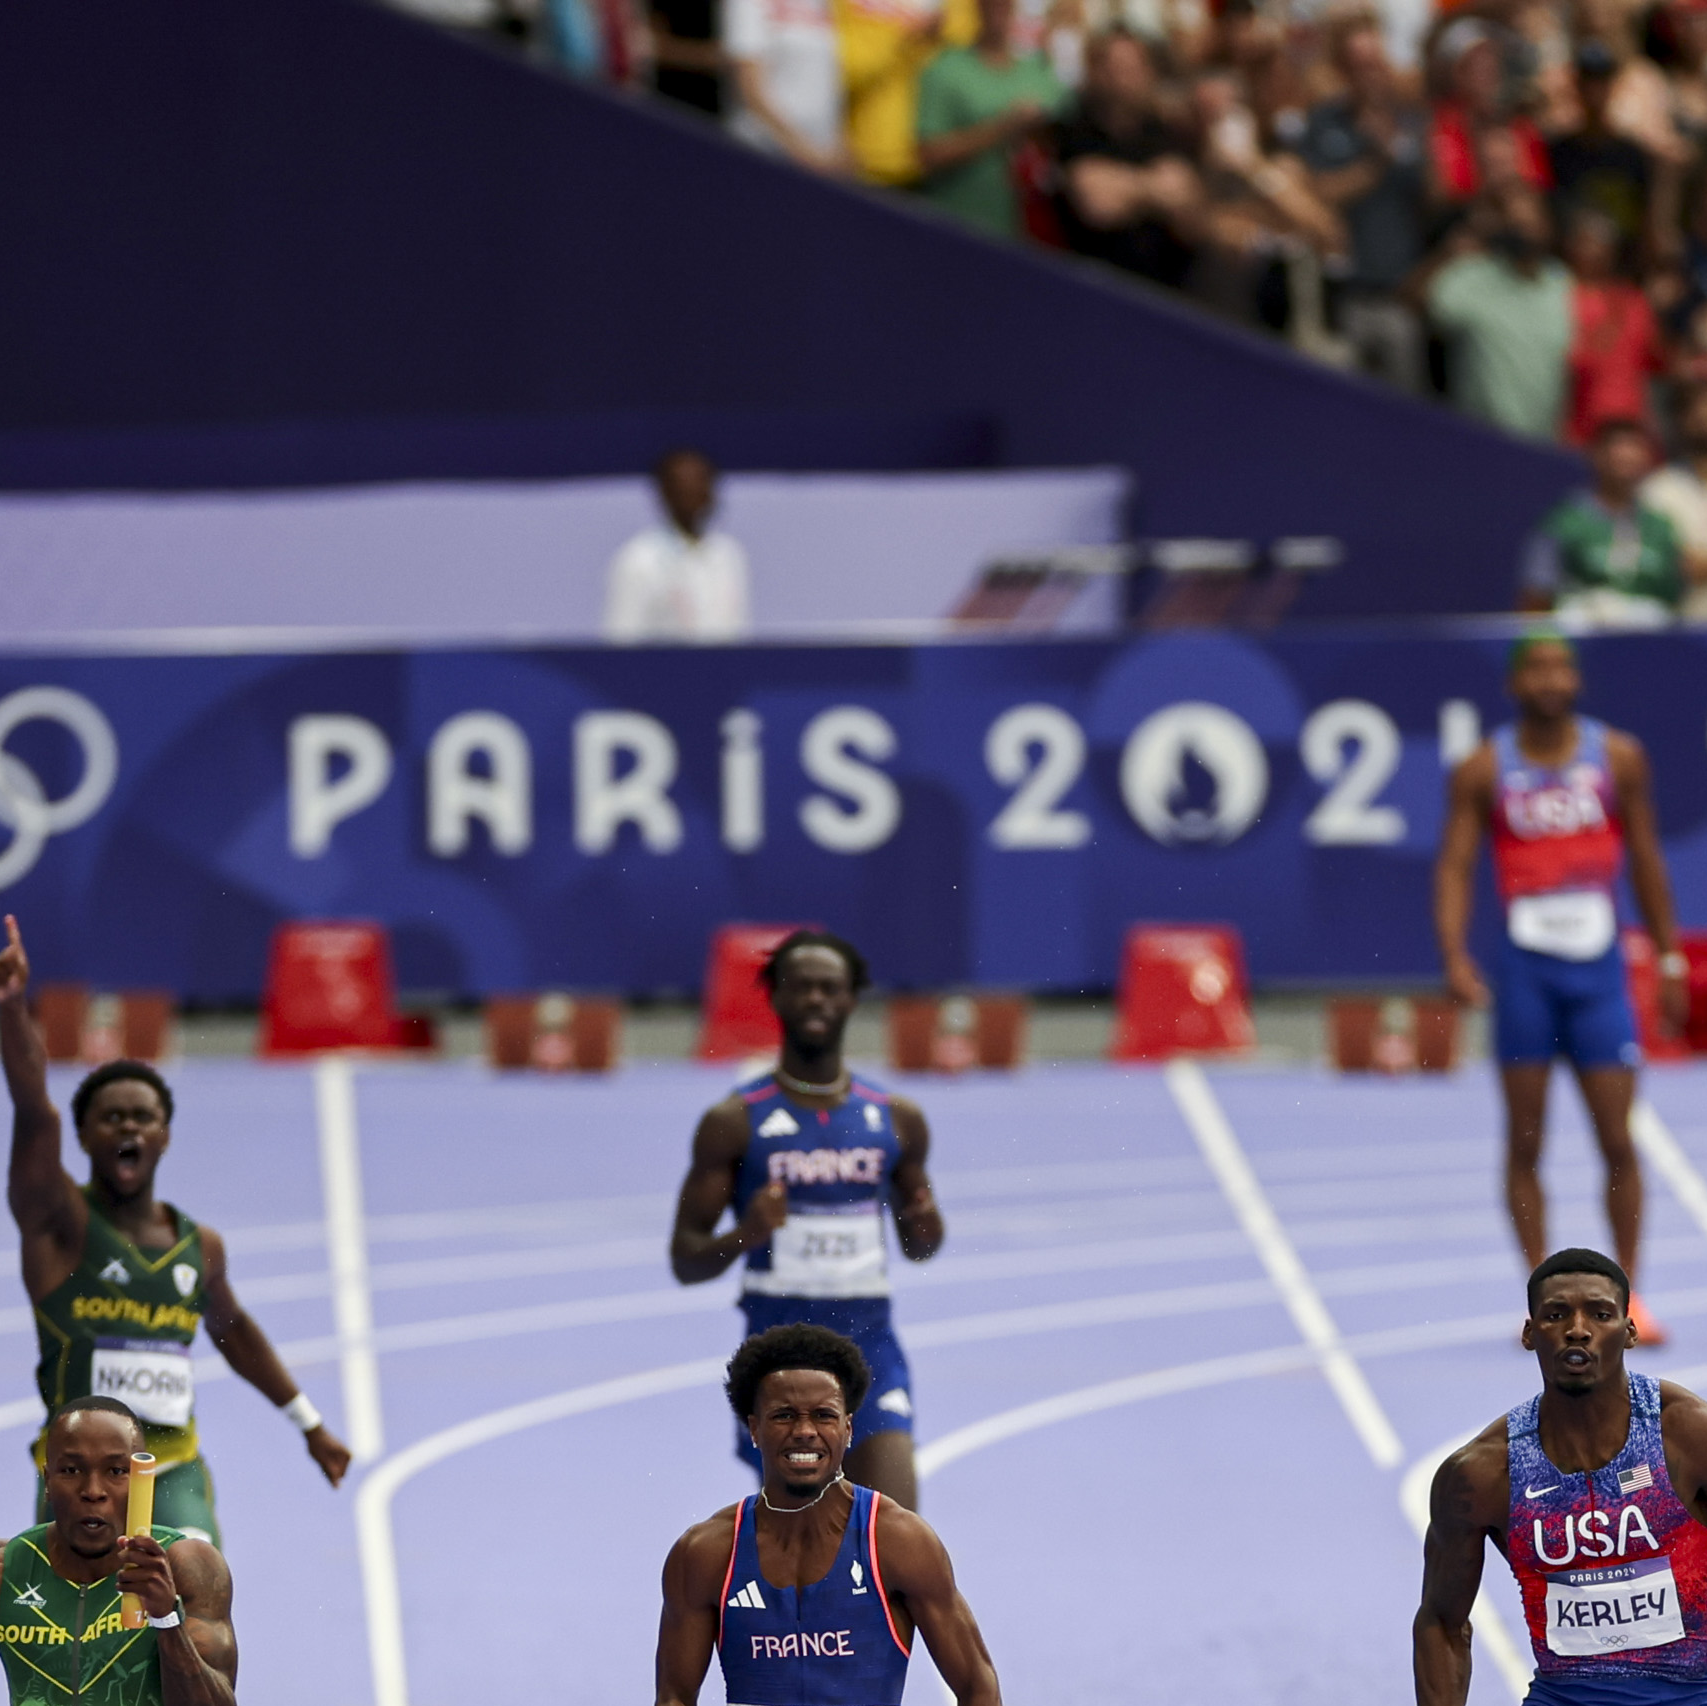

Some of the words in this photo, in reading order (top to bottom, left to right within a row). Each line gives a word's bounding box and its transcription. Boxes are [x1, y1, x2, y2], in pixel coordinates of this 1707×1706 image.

[1534, 1505, 1660, 1566] USA
[1607, 1567, 1636, 1579] 2024
[134, 1610, 143, 1623] 7
[1557, 1588, 1666, 1628] KERLEY
[750, 1630, 855, 1659] FRANCE
